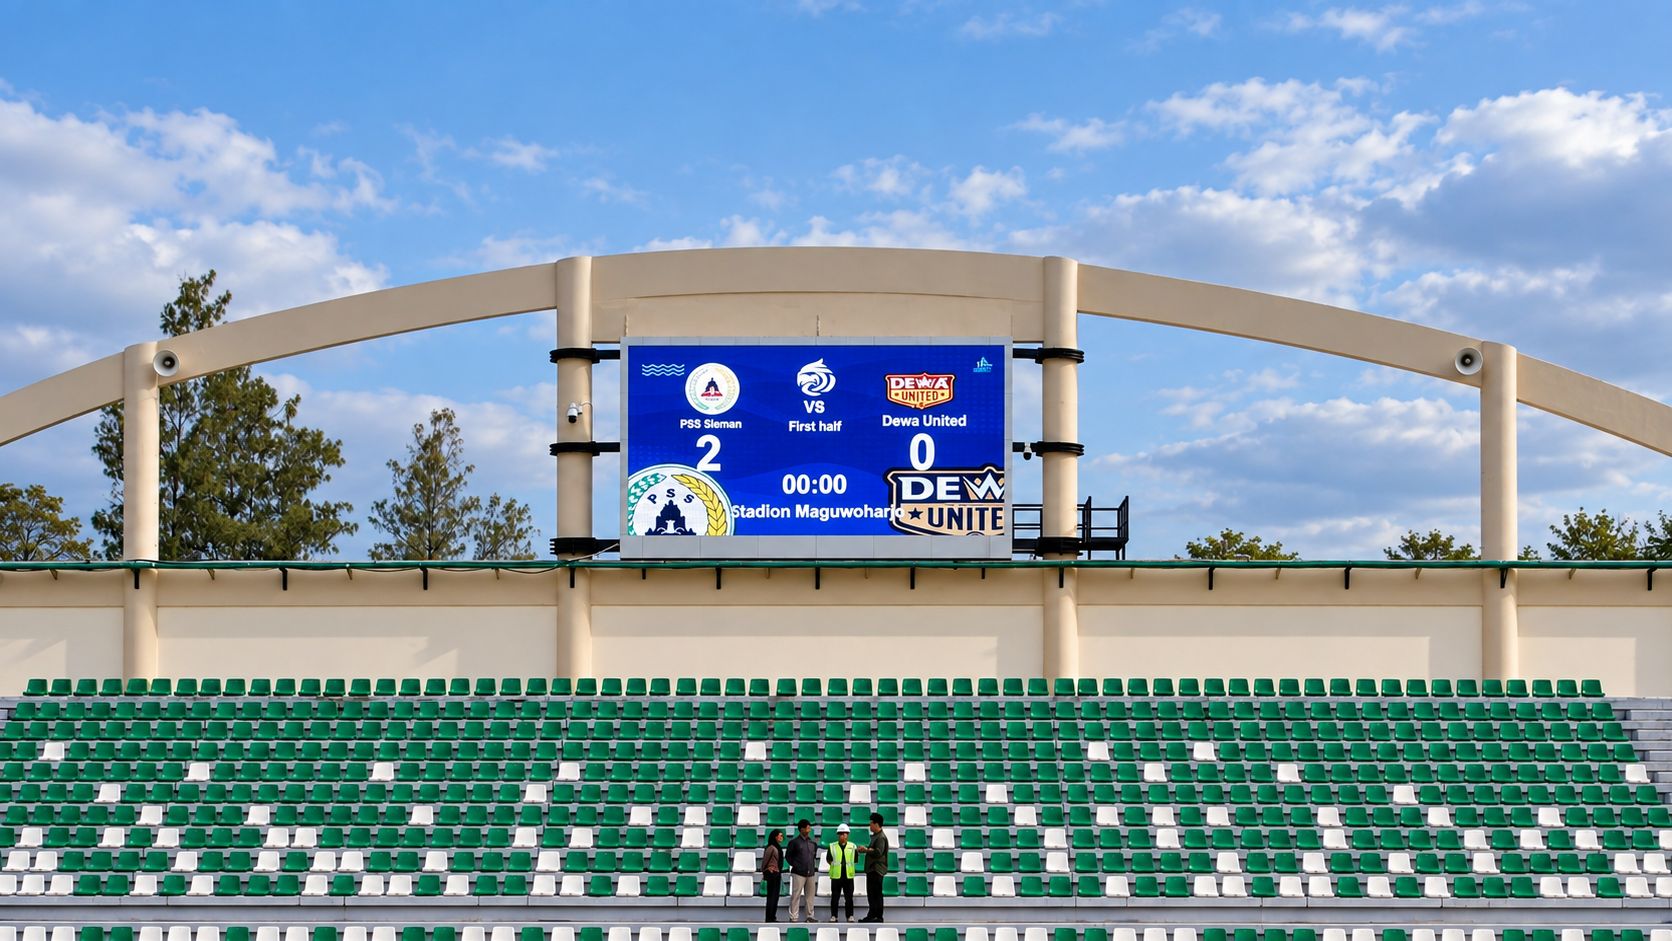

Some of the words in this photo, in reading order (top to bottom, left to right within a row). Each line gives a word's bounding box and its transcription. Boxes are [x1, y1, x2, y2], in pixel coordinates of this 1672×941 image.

[901, 390, 939, 402] UNITED
[803, 400, 825, 414] VS
[680, 419, 702, 429] PSS
[703, 419, 742, 429] Sleman
[789, 420, 817, 432] First
[818, 420, 842, 432] half
[882, 414, 919, 427] Dewa
[923, 414, 967, 427] United
[696, 434, 721, 472] 2
[909, 433, 936, 471] 0
[782, 474, 847, 494] 00:00
[647, 488, 695, 505] PSS
[732, 504, 790, 518] Stadion
[796, 504, 905, 522] Maguwoharjo
